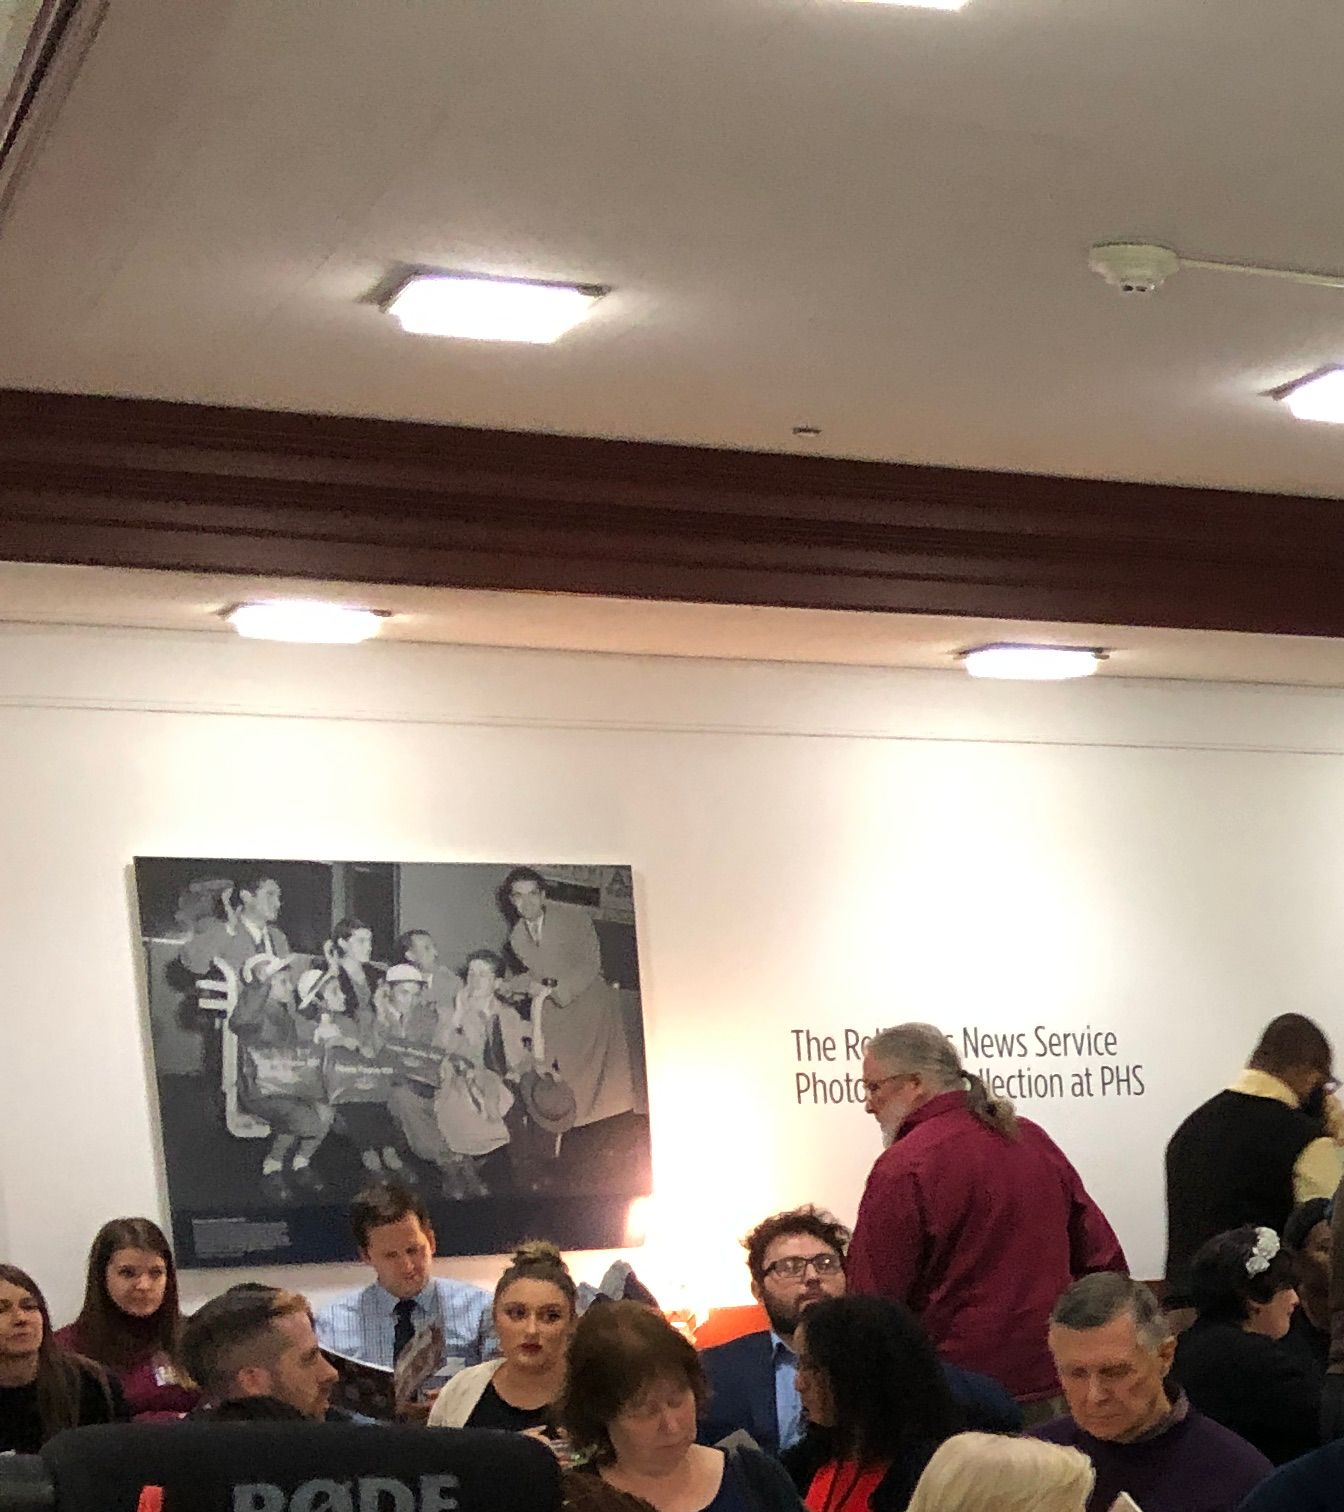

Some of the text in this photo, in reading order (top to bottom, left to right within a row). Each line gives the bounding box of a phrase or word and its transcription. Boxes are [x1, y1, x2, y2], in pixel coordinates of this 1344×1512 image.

[791, 1029, 836, 1062] The
[962, 1026, 1028, 1058] News
[1034, 1025, 1118, 1057] Service
[1071, 1067, 1094, 1097] at
[1100, 1064, 1145, 1097] PHS
